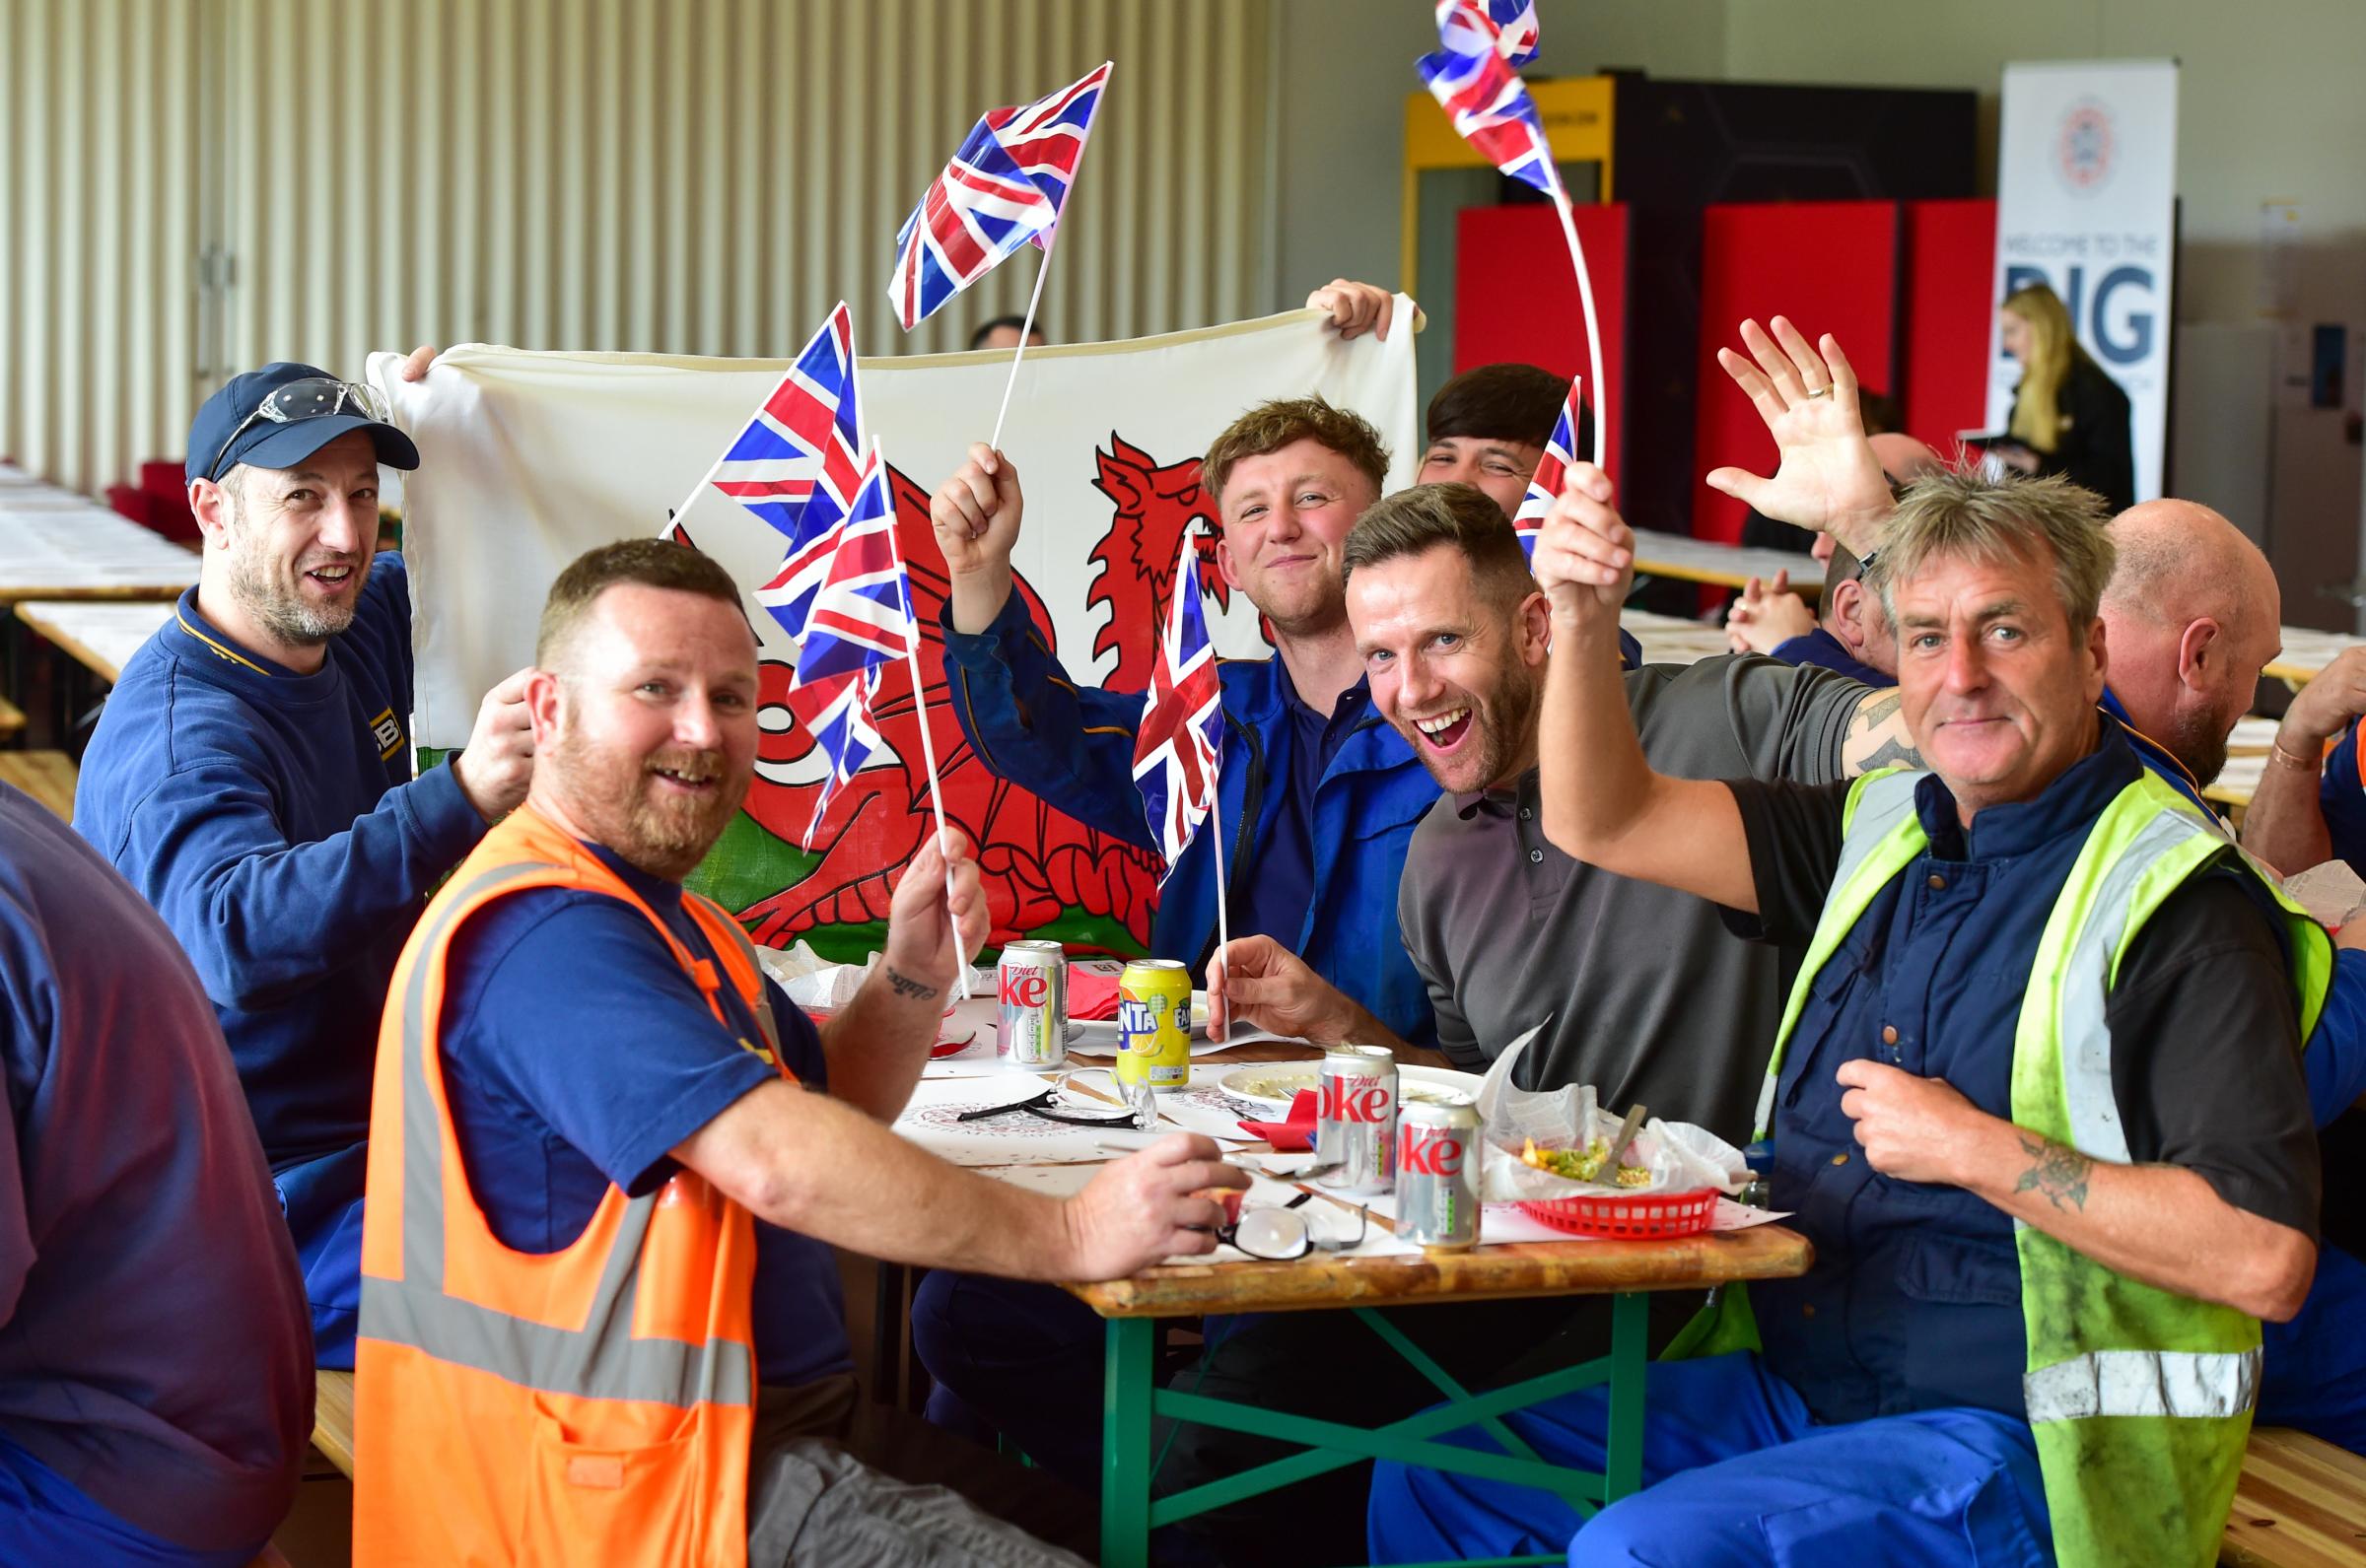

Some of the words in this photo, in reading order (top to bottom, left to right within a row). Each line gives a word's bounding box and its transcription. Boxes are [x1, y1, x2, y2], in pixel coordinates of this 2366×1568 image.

[2005, 234, 2087, 256] WELCOME
[2095, 233, 2120, 257] TO
[2123, 233, 2157, 257] THE
[375, 719, 399, 751] B
[1009, 963, 1039, 976] Diet
[998, 965, 1048, 1008] ke
[1347, 1073, 1381, 1087] Diet
[1397, 1123, 1462, 1177] ke
